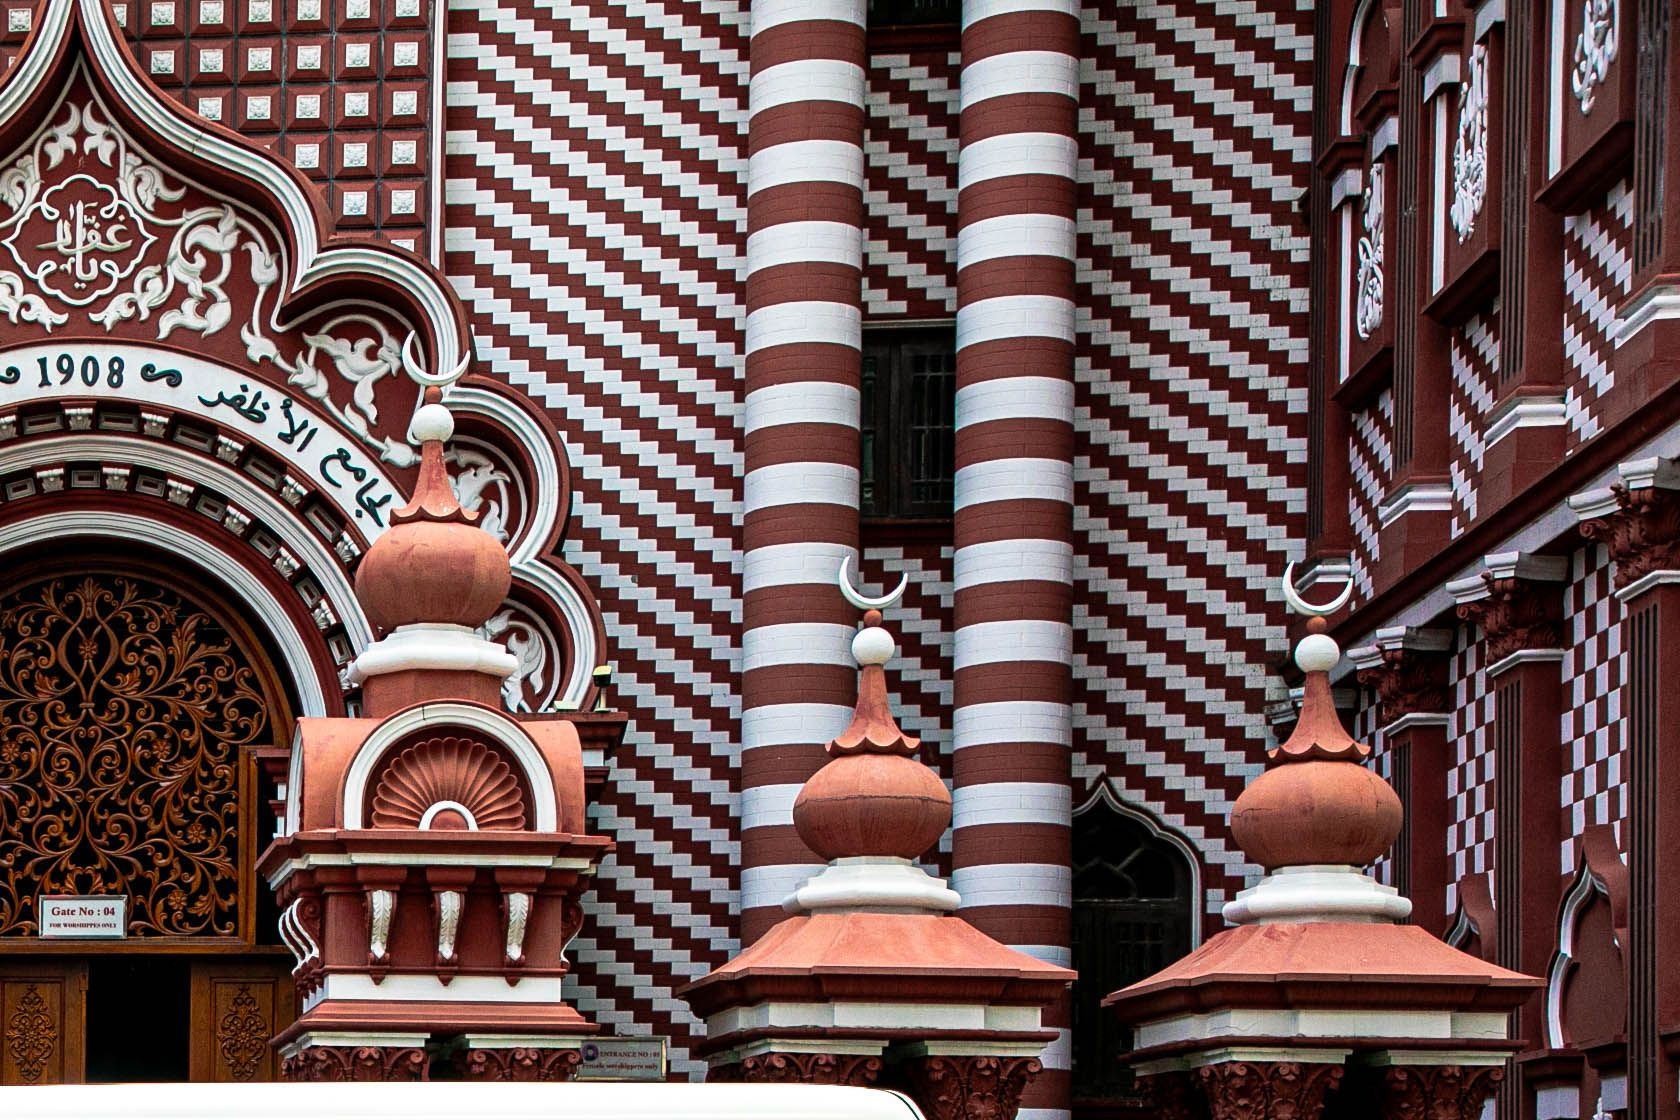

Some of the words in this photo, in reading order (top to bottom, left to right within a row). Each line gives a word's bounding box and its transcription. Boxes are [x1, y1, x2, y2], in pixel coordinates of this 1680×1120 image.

[36, 353, 125, 389] 1908
[51, 906, 76, 916] Gate
[79, 907, 94, 916] No
[103, 906, 115, 916] 04
